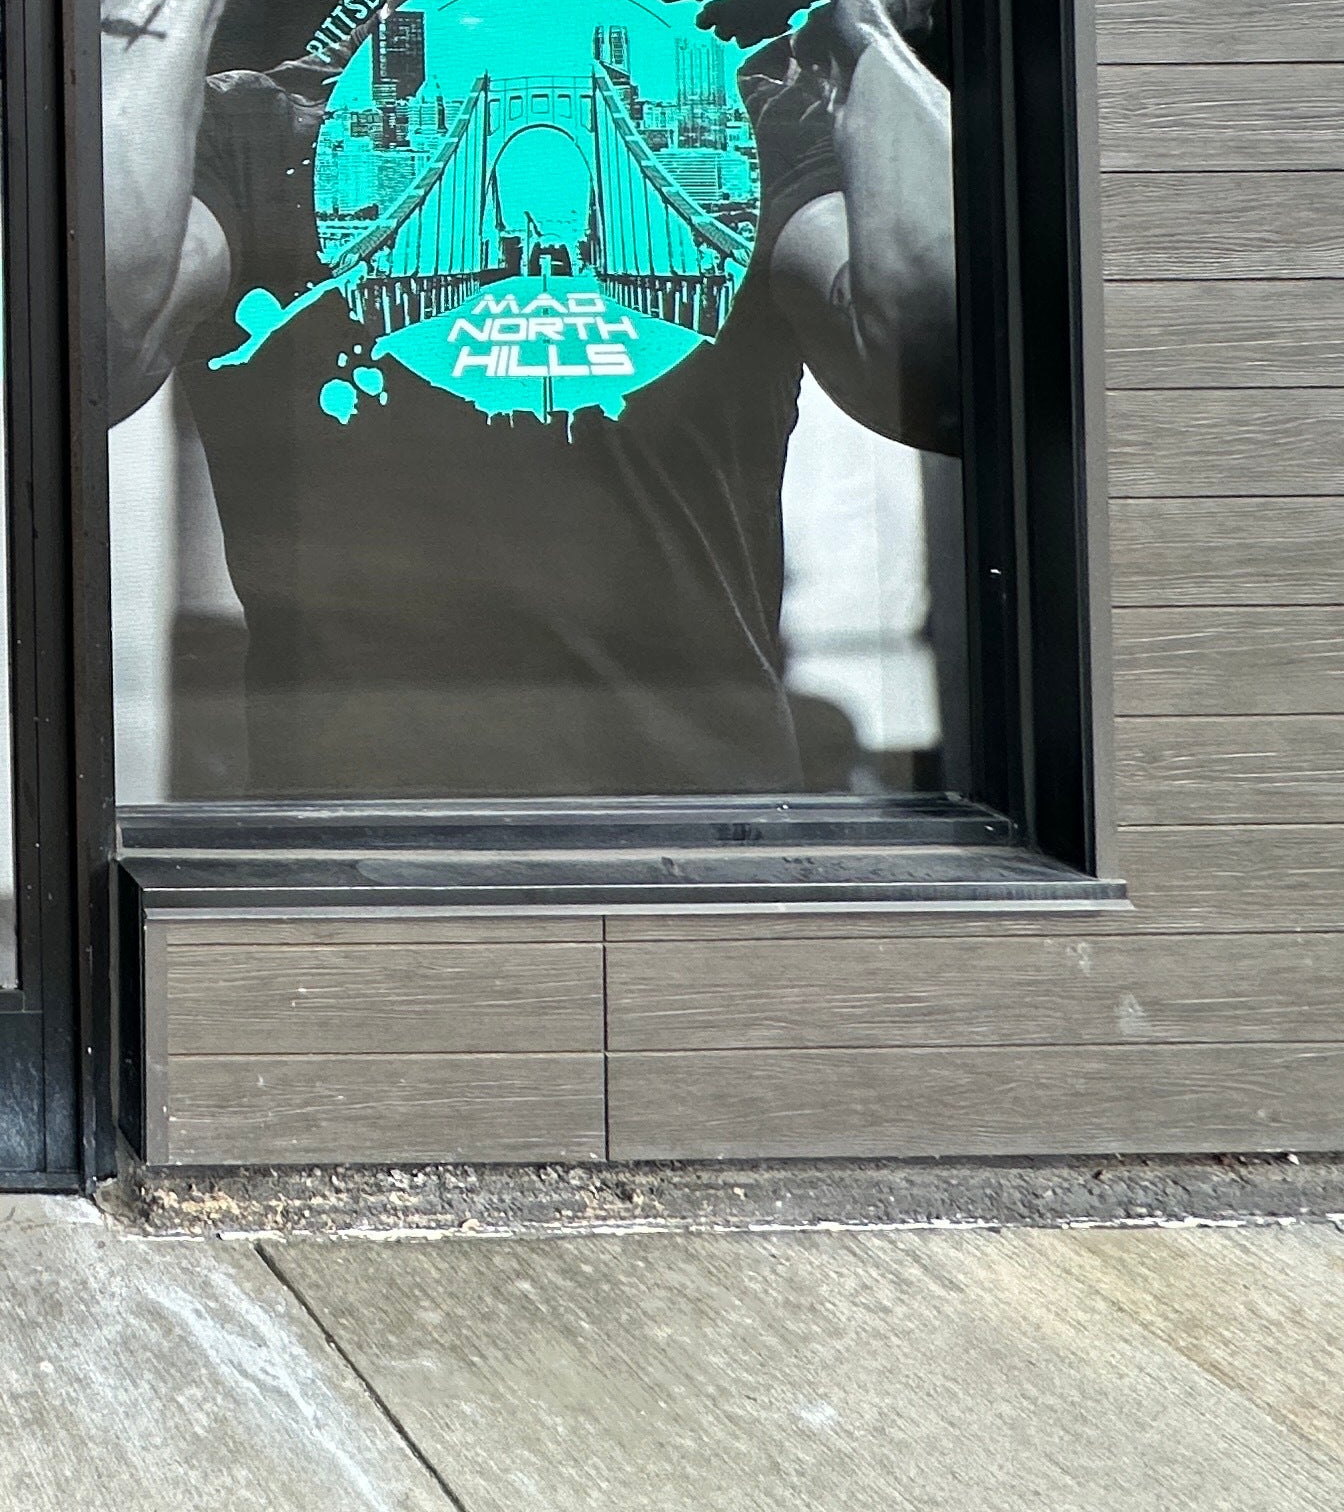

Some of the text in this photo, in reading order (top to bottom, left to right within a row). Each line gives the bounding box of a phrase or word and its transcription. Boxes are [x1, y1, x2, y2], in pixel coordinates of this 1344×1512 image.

[471, 292, 607, 315] MAD
[446, 315, 640, 343] NORTH
[451, 343, 636, 378] HILLS
